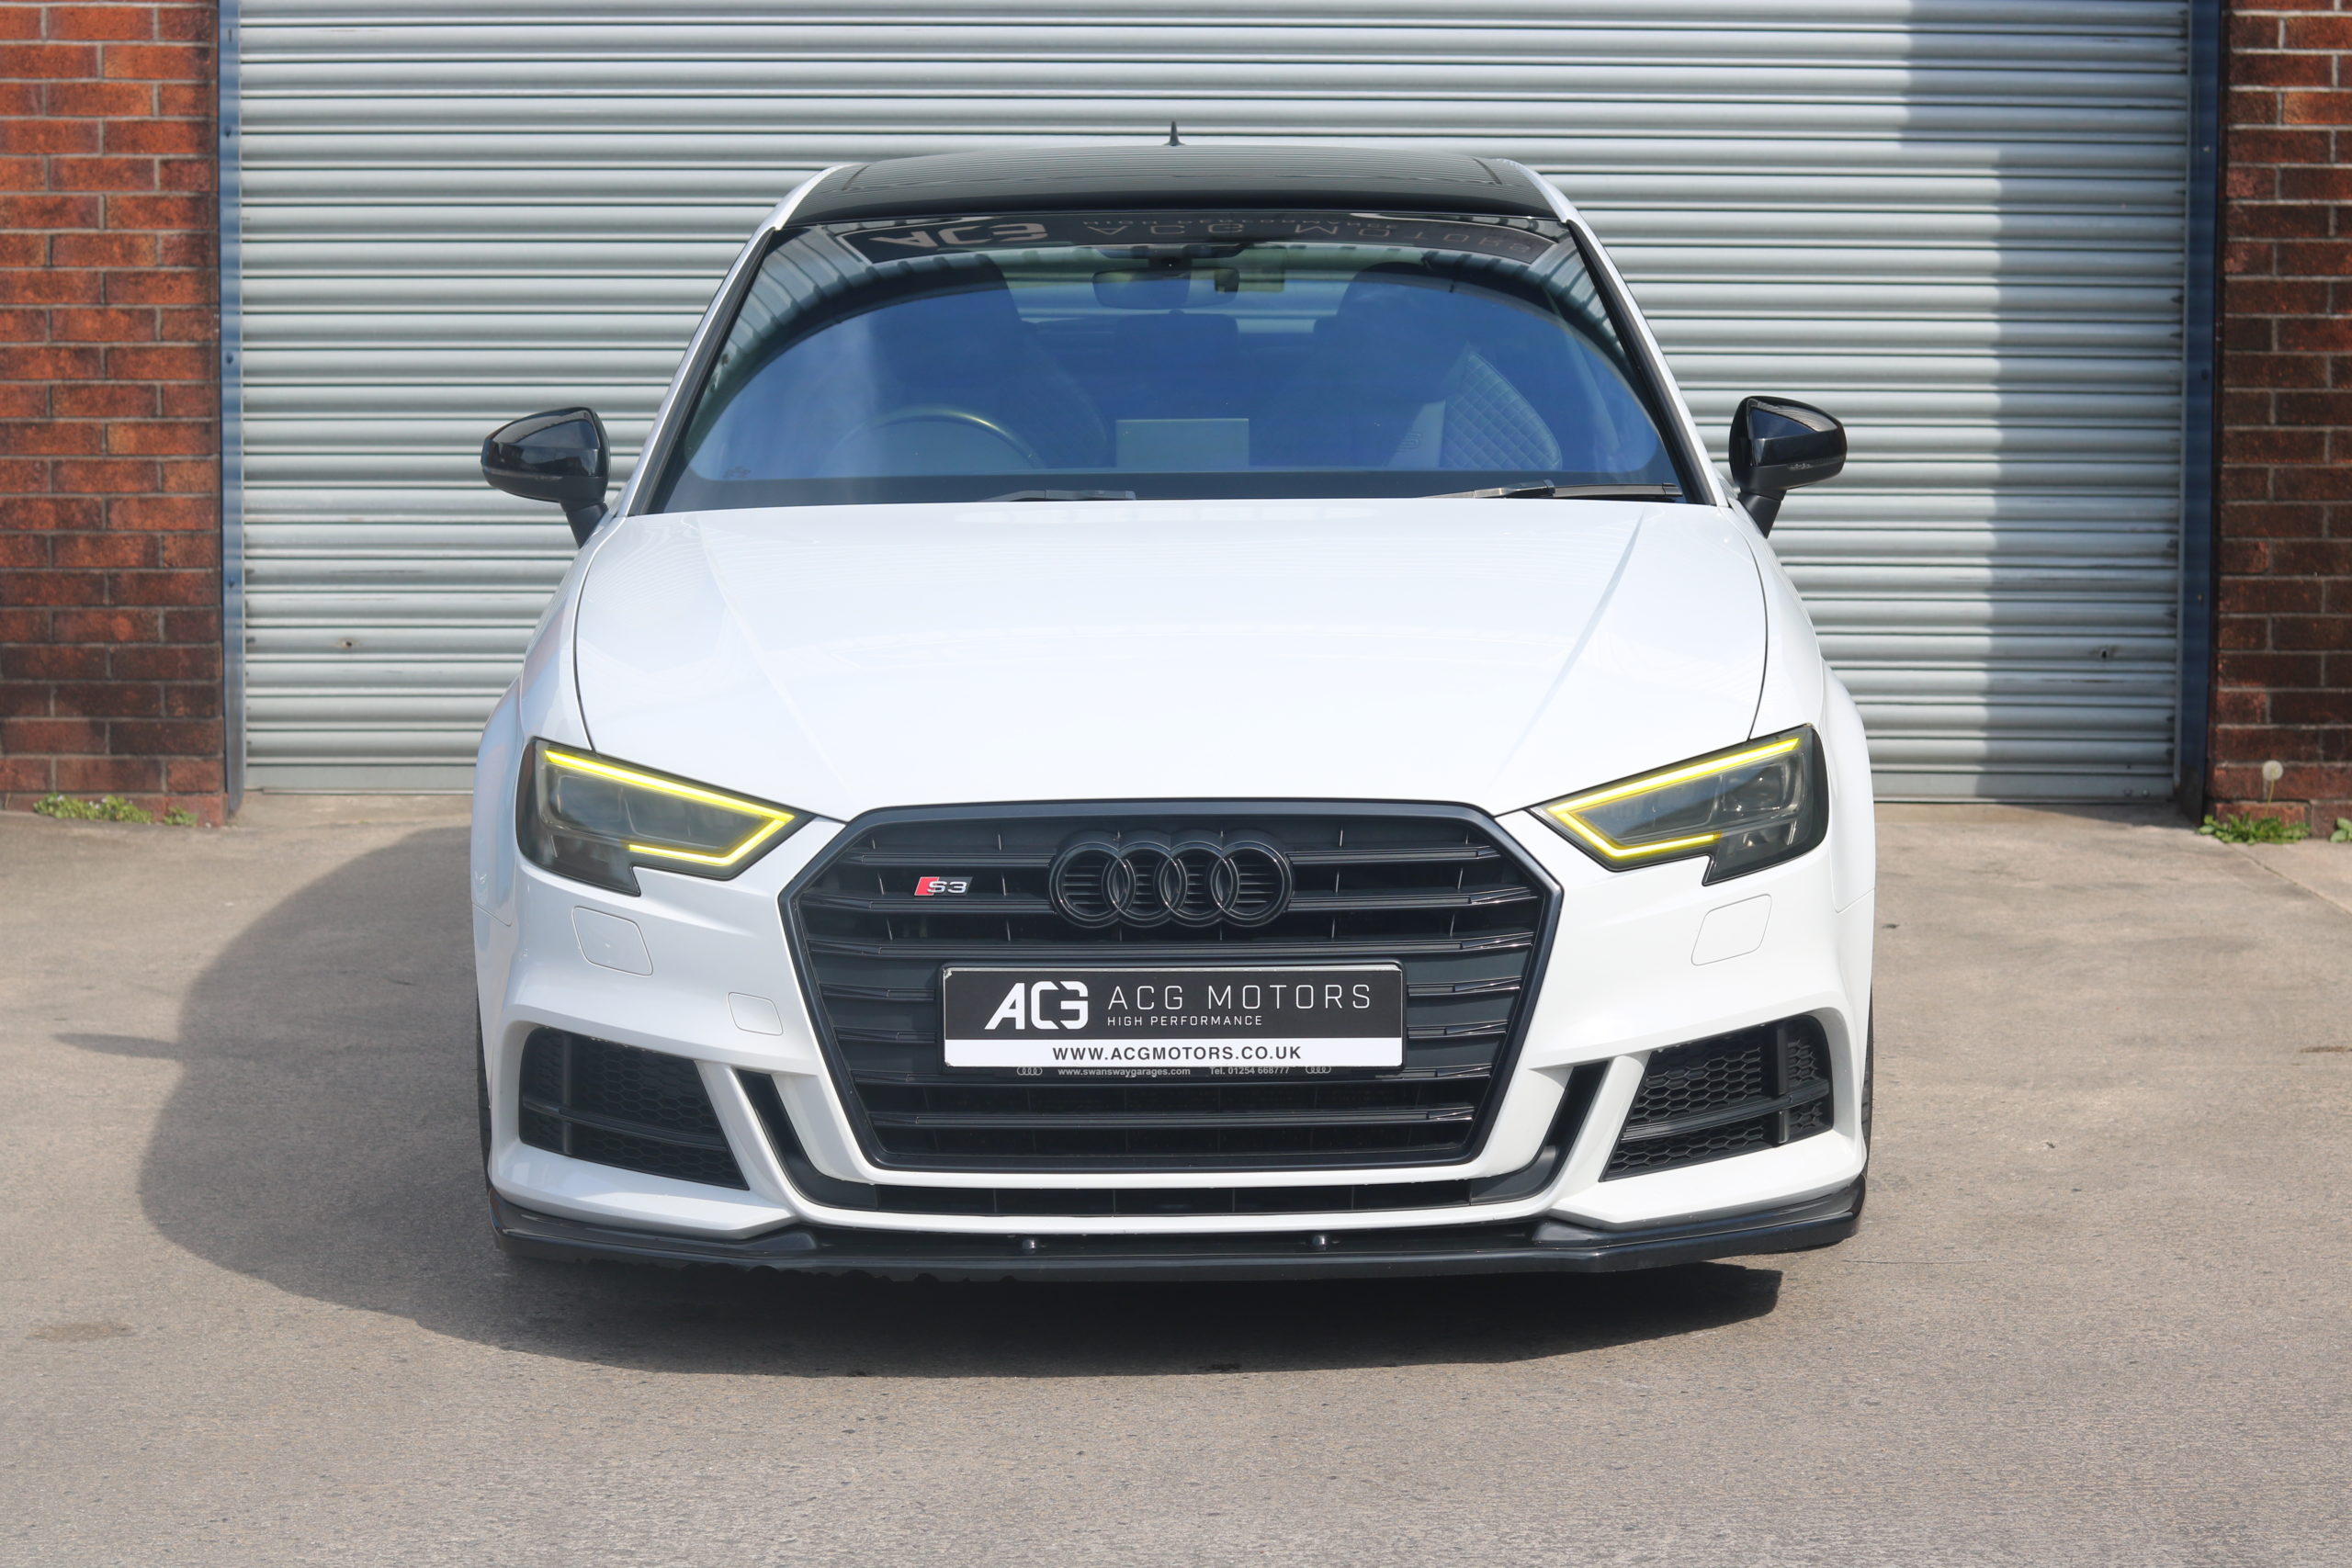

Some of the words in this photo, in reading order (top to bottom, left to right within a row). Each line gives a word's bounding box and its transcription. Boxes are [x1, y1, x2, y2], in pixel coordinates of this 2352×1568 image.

[926, 880, 967, 894] S3
[1108, 985, 1183, 1010] ACG
[1208, 984, 1371, 1010] MOTORS
[984, 980, 1089, 1030] ACG
[1107, 1016, 1143, 1026] HIGH
[1150, 1015, 1262, 1026] PERFORMANCE
[1052, 1046, 1302, 1060] WWW.ACGMOTORS.CO.UK
[1057, 1067, 1192, 1077] www.swanswaygarages.com
[1210, 1066, 1226, 1075] Tel.
[1227, 1066, 1255, 1075] 01254
[1257, 1066, 1290, 1075] 668777
